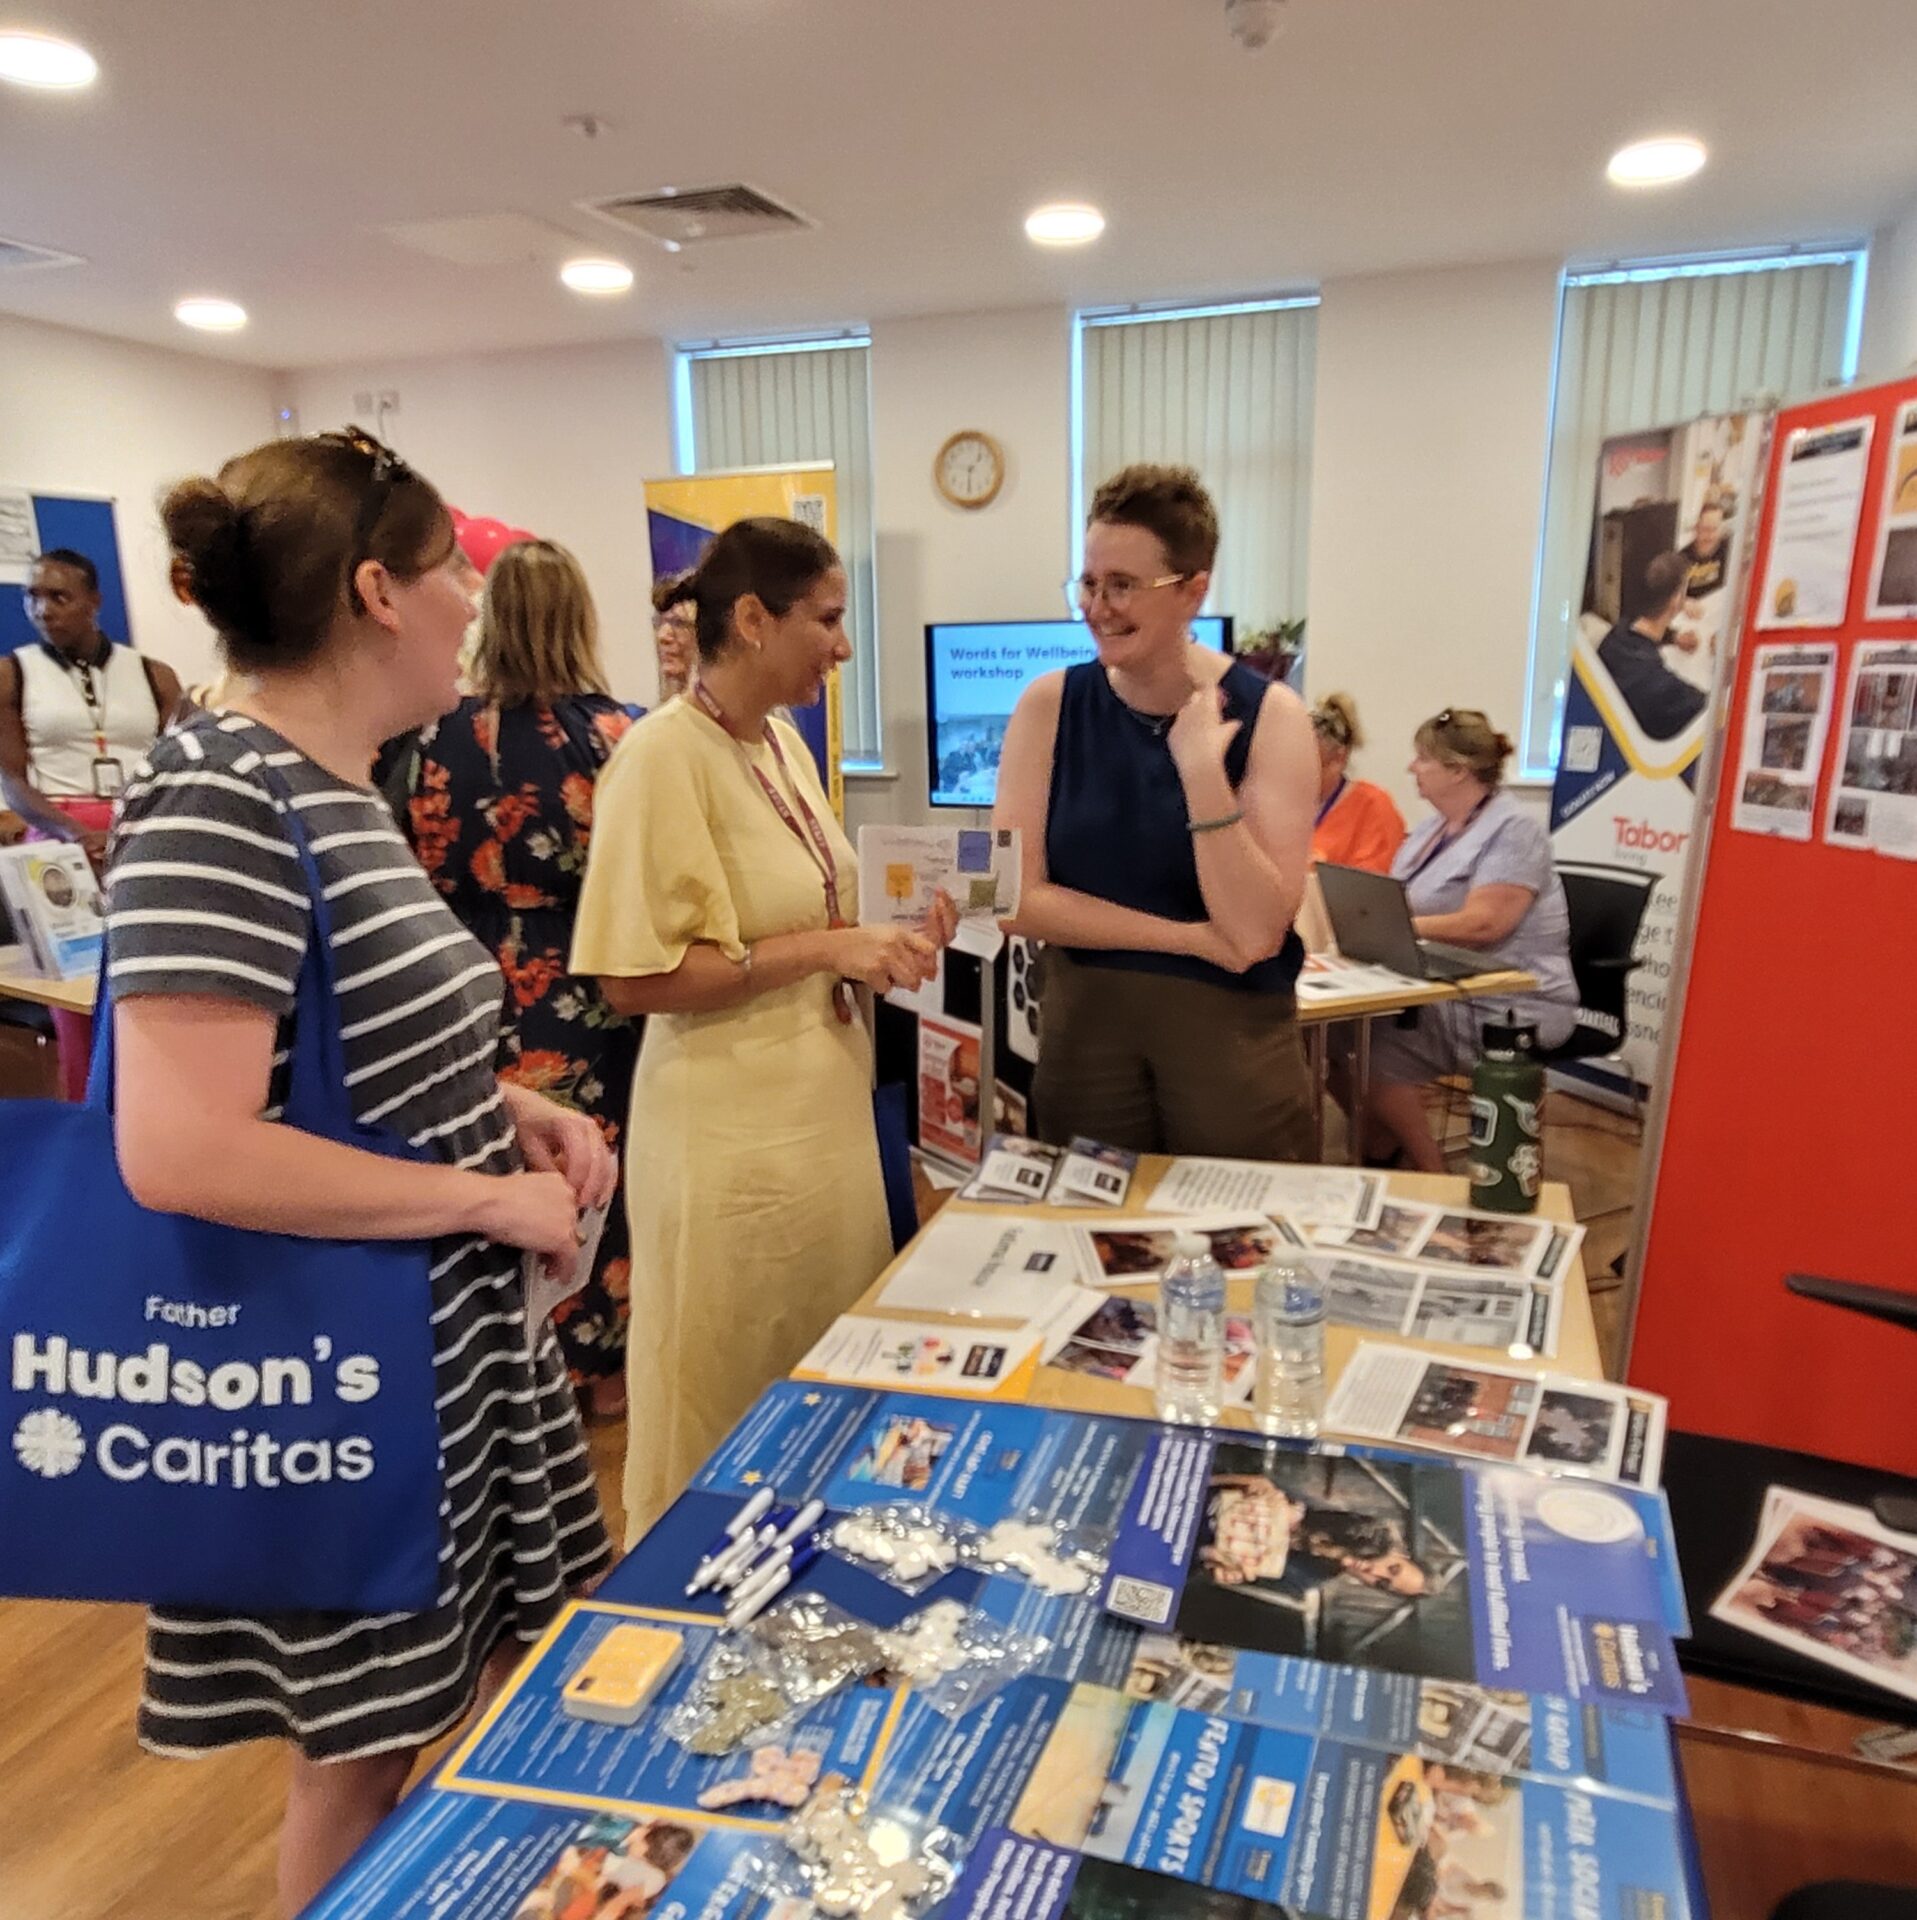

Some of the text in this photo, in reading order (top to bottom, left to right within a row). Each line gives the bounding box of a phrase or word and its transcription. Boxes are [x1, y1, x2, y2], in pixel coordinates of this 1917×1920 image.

[950, 646, 1095, 660] Words for Wellbein
[951, 667, 1024, 680] workshop
[1613, 816, 1689, 853] Tabor
[145, 1296, 242, 1329] Father
[12, 1332, 382, 1412] Hudson's
[96, 1422, 375, 1490] Caritas
[1185, 1716, 1230, 1792] FENTON
[1157, 1791, 1208, 1874] SPORTS
